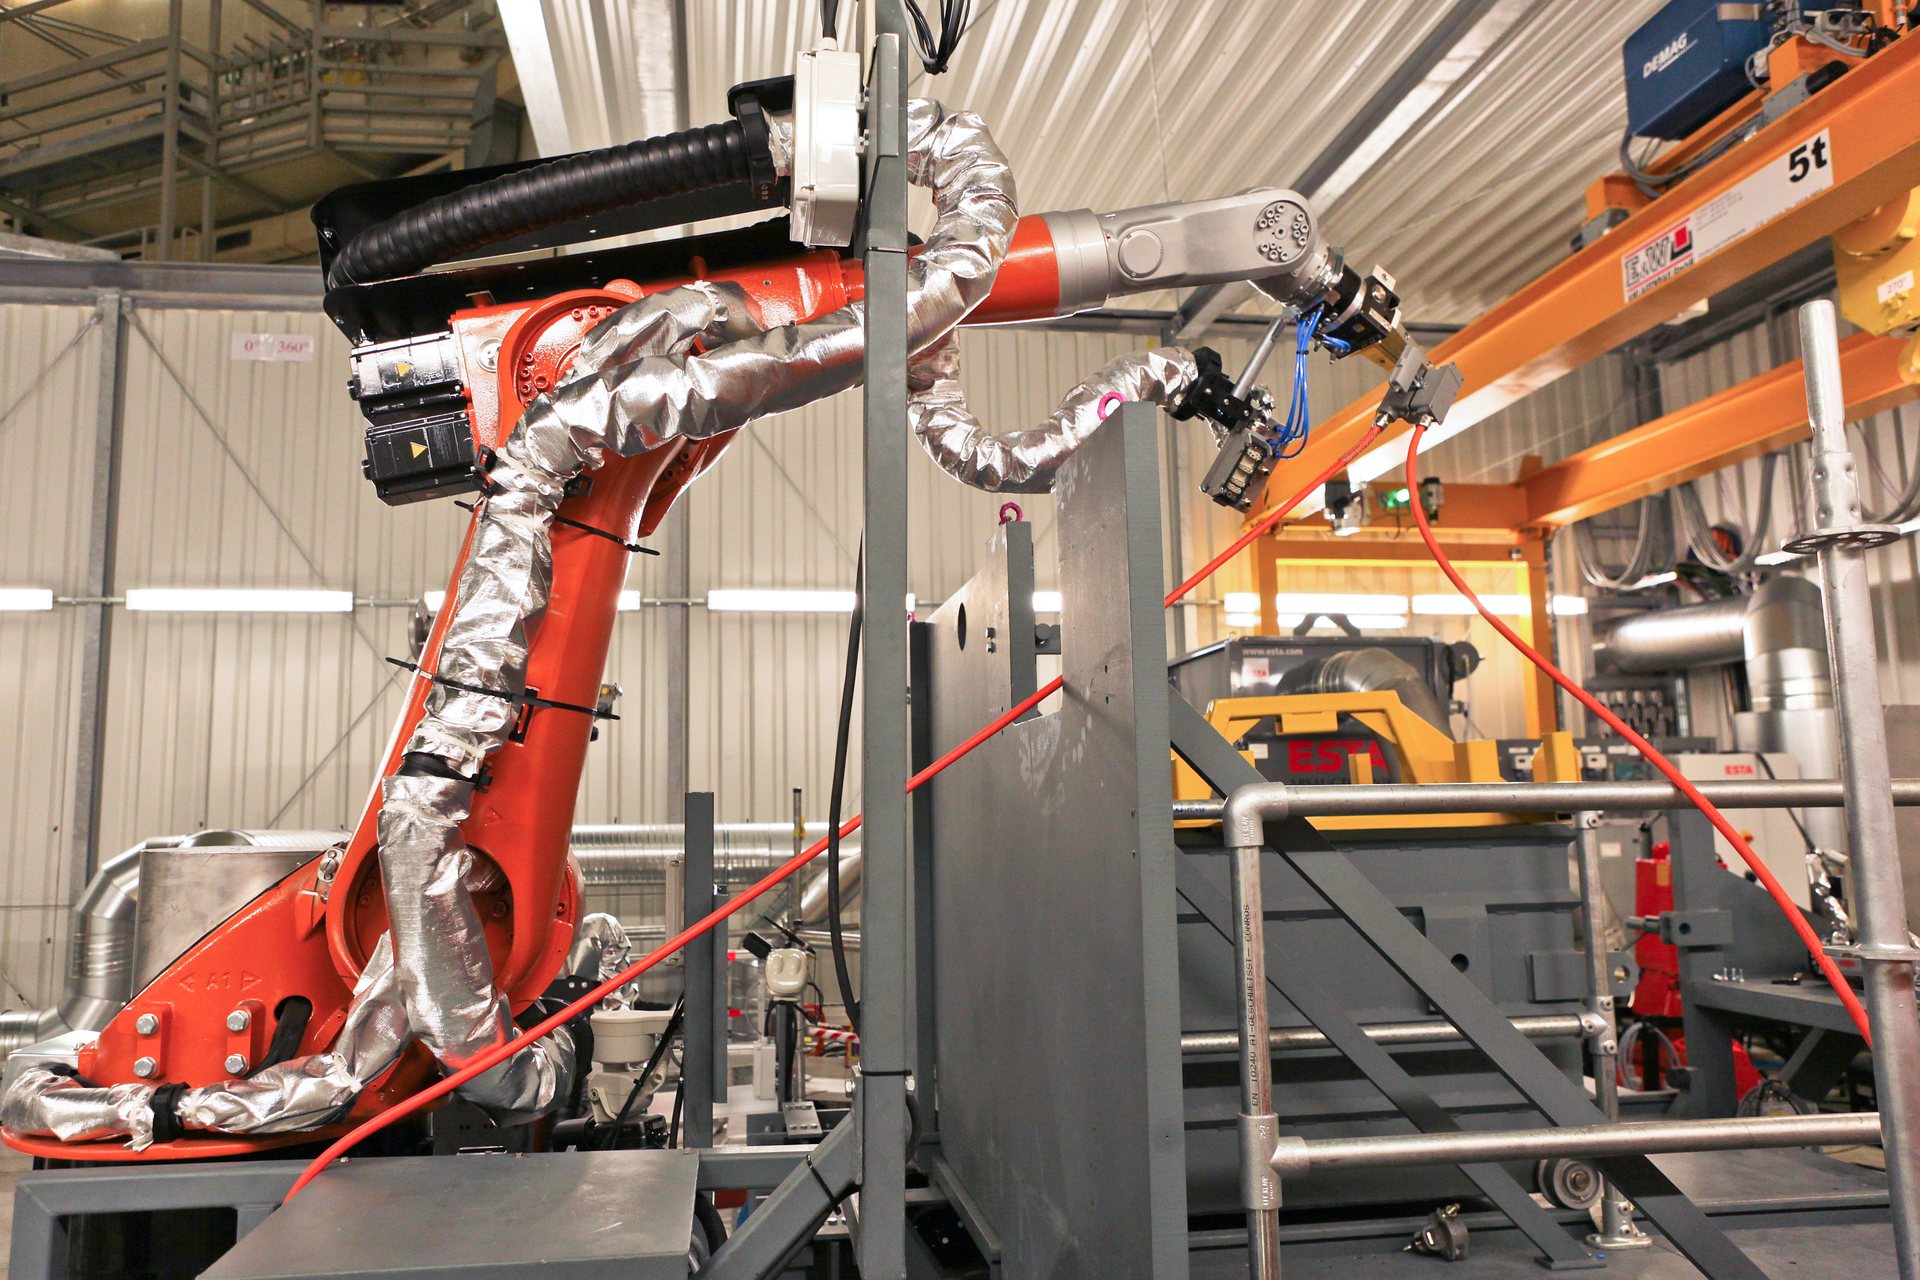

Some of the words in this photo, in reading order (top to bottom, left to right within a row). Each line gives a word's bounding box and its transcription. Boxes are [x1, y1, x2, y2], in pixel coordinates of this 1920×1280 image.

[1643, 32, 1688, 79] DEMAG
[1788, 136, 1828, 184] 5t
[277, 340, 310, 354] 360°
[1242, 648, 1304, 656] www.esta.com
[1288, 740, 1388, 773] ESTA
[1725, 764, 1754, 776] ESTA
[1243, 904, 1252, 942] CONROS
[1250, 1051, 1258, 1082] 10240
[1251, 1092, 1259, 1107] EN
